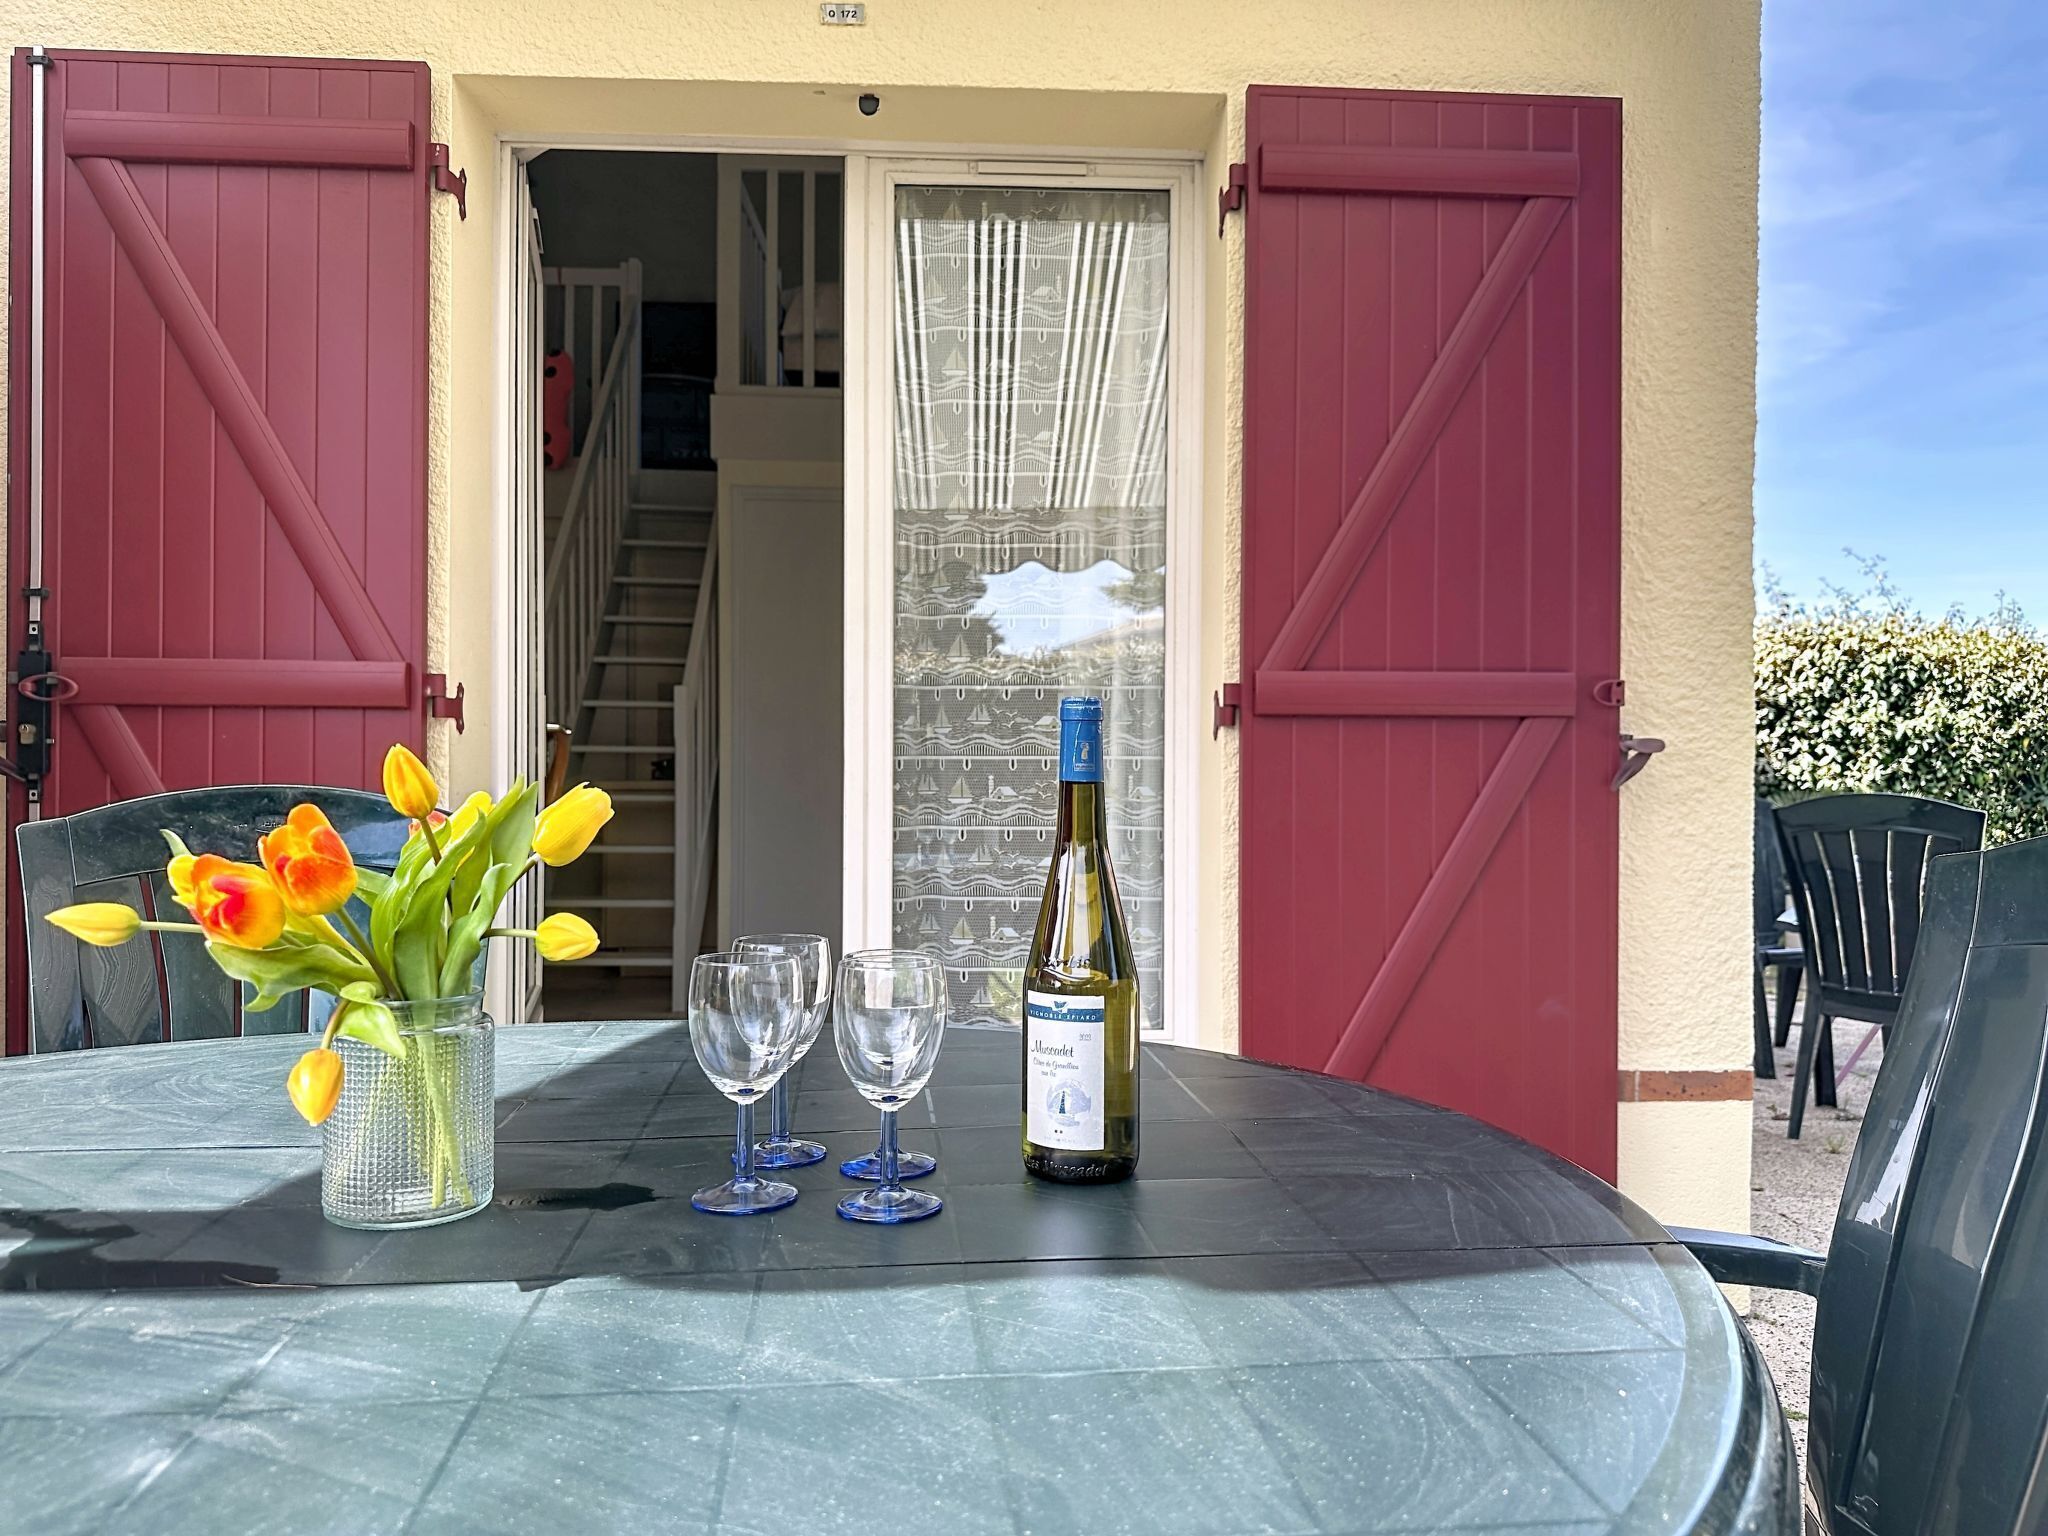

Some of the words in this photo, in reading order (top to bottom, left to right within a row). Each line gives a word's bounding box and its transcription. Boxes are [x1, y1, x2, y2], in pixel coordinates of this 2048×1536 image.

[840, 9, 857, 18] 172
[1030, 1009, 1062, 1020] VIGNOBLE
[1031, 1039, 1075, 1058] Muscadet
